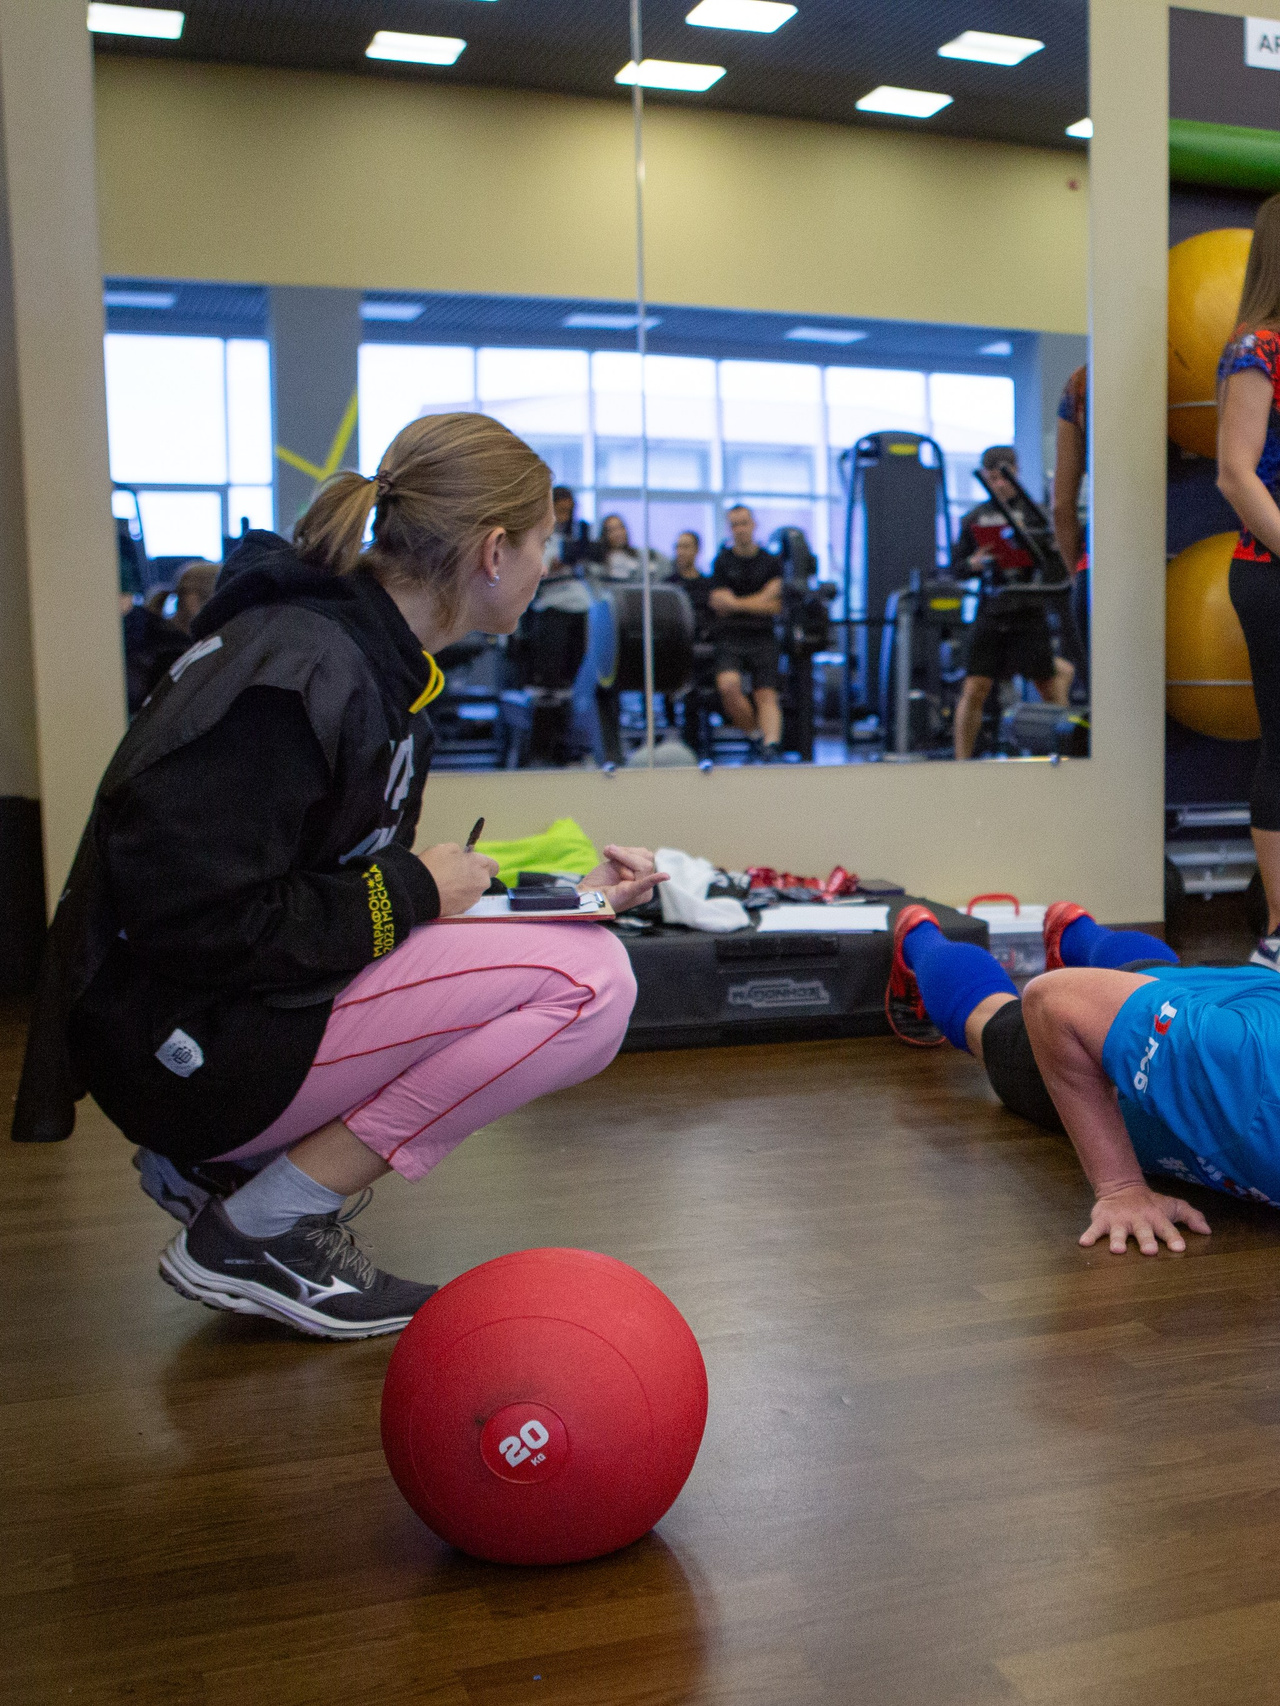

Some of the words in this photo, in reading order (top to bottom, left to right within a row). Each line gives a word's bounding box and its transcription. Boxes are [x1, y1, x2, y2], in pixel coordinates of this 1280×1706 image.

[369, 864, 393, 922] МОСКВА
[368, 889, 384, 958] МАРАФОН
[382, 923, 395, 955] 2023
[499, 1420, 549, 1468] 20
[530, 1452, 547, 1467] KG
